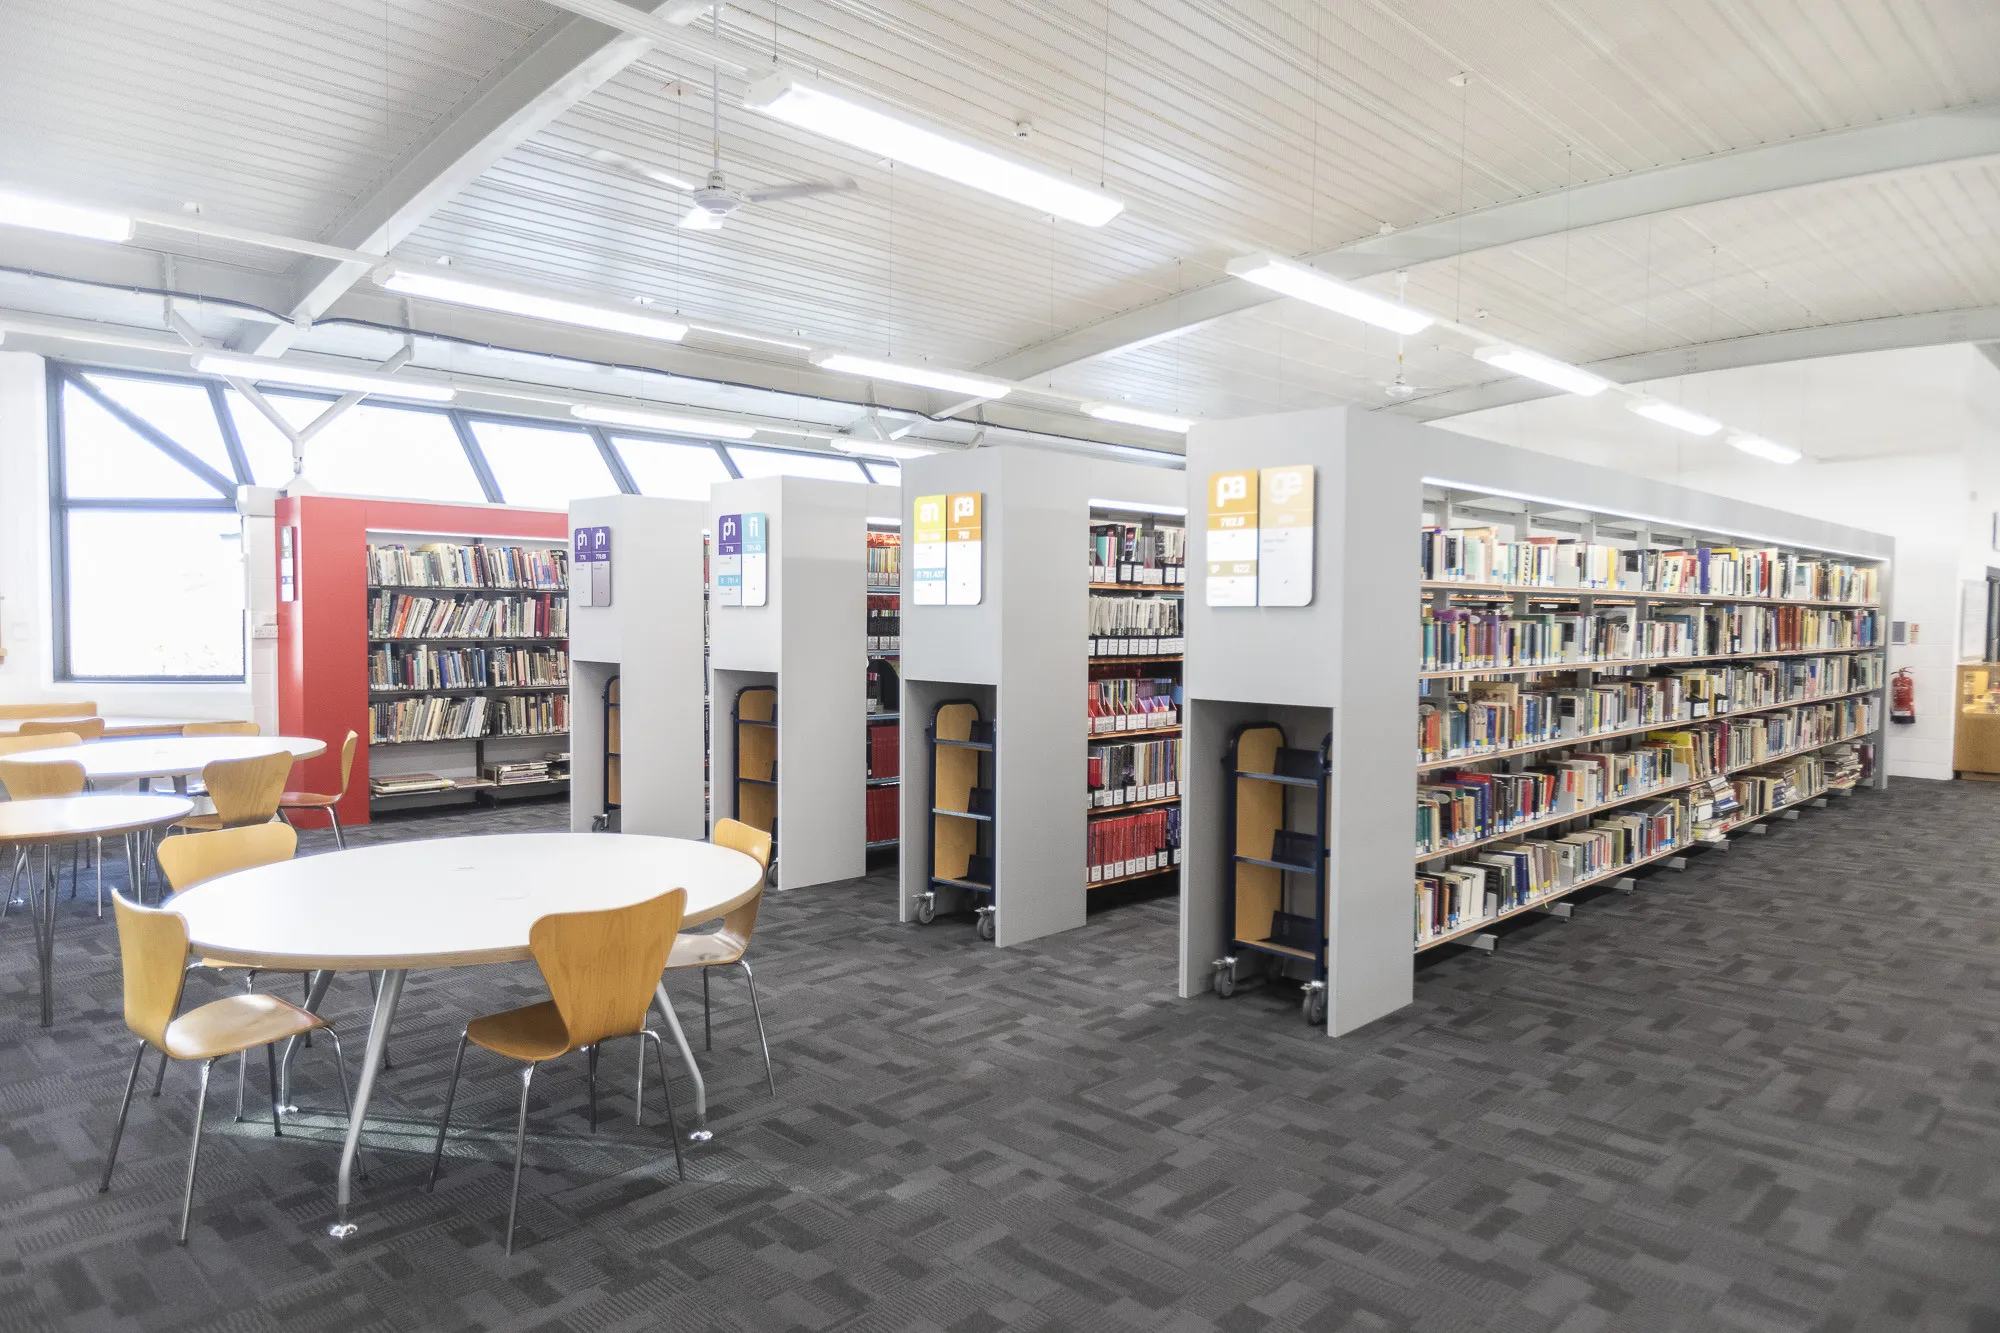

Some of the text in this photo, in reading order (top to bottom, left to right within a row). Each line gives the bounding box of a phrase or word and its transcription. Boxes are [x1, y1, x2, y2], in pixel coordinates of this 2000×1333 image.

[595, 528, 606, 549] ph
[723, 517, 736, 541] ph
[577, 530, 588, 550] ph
